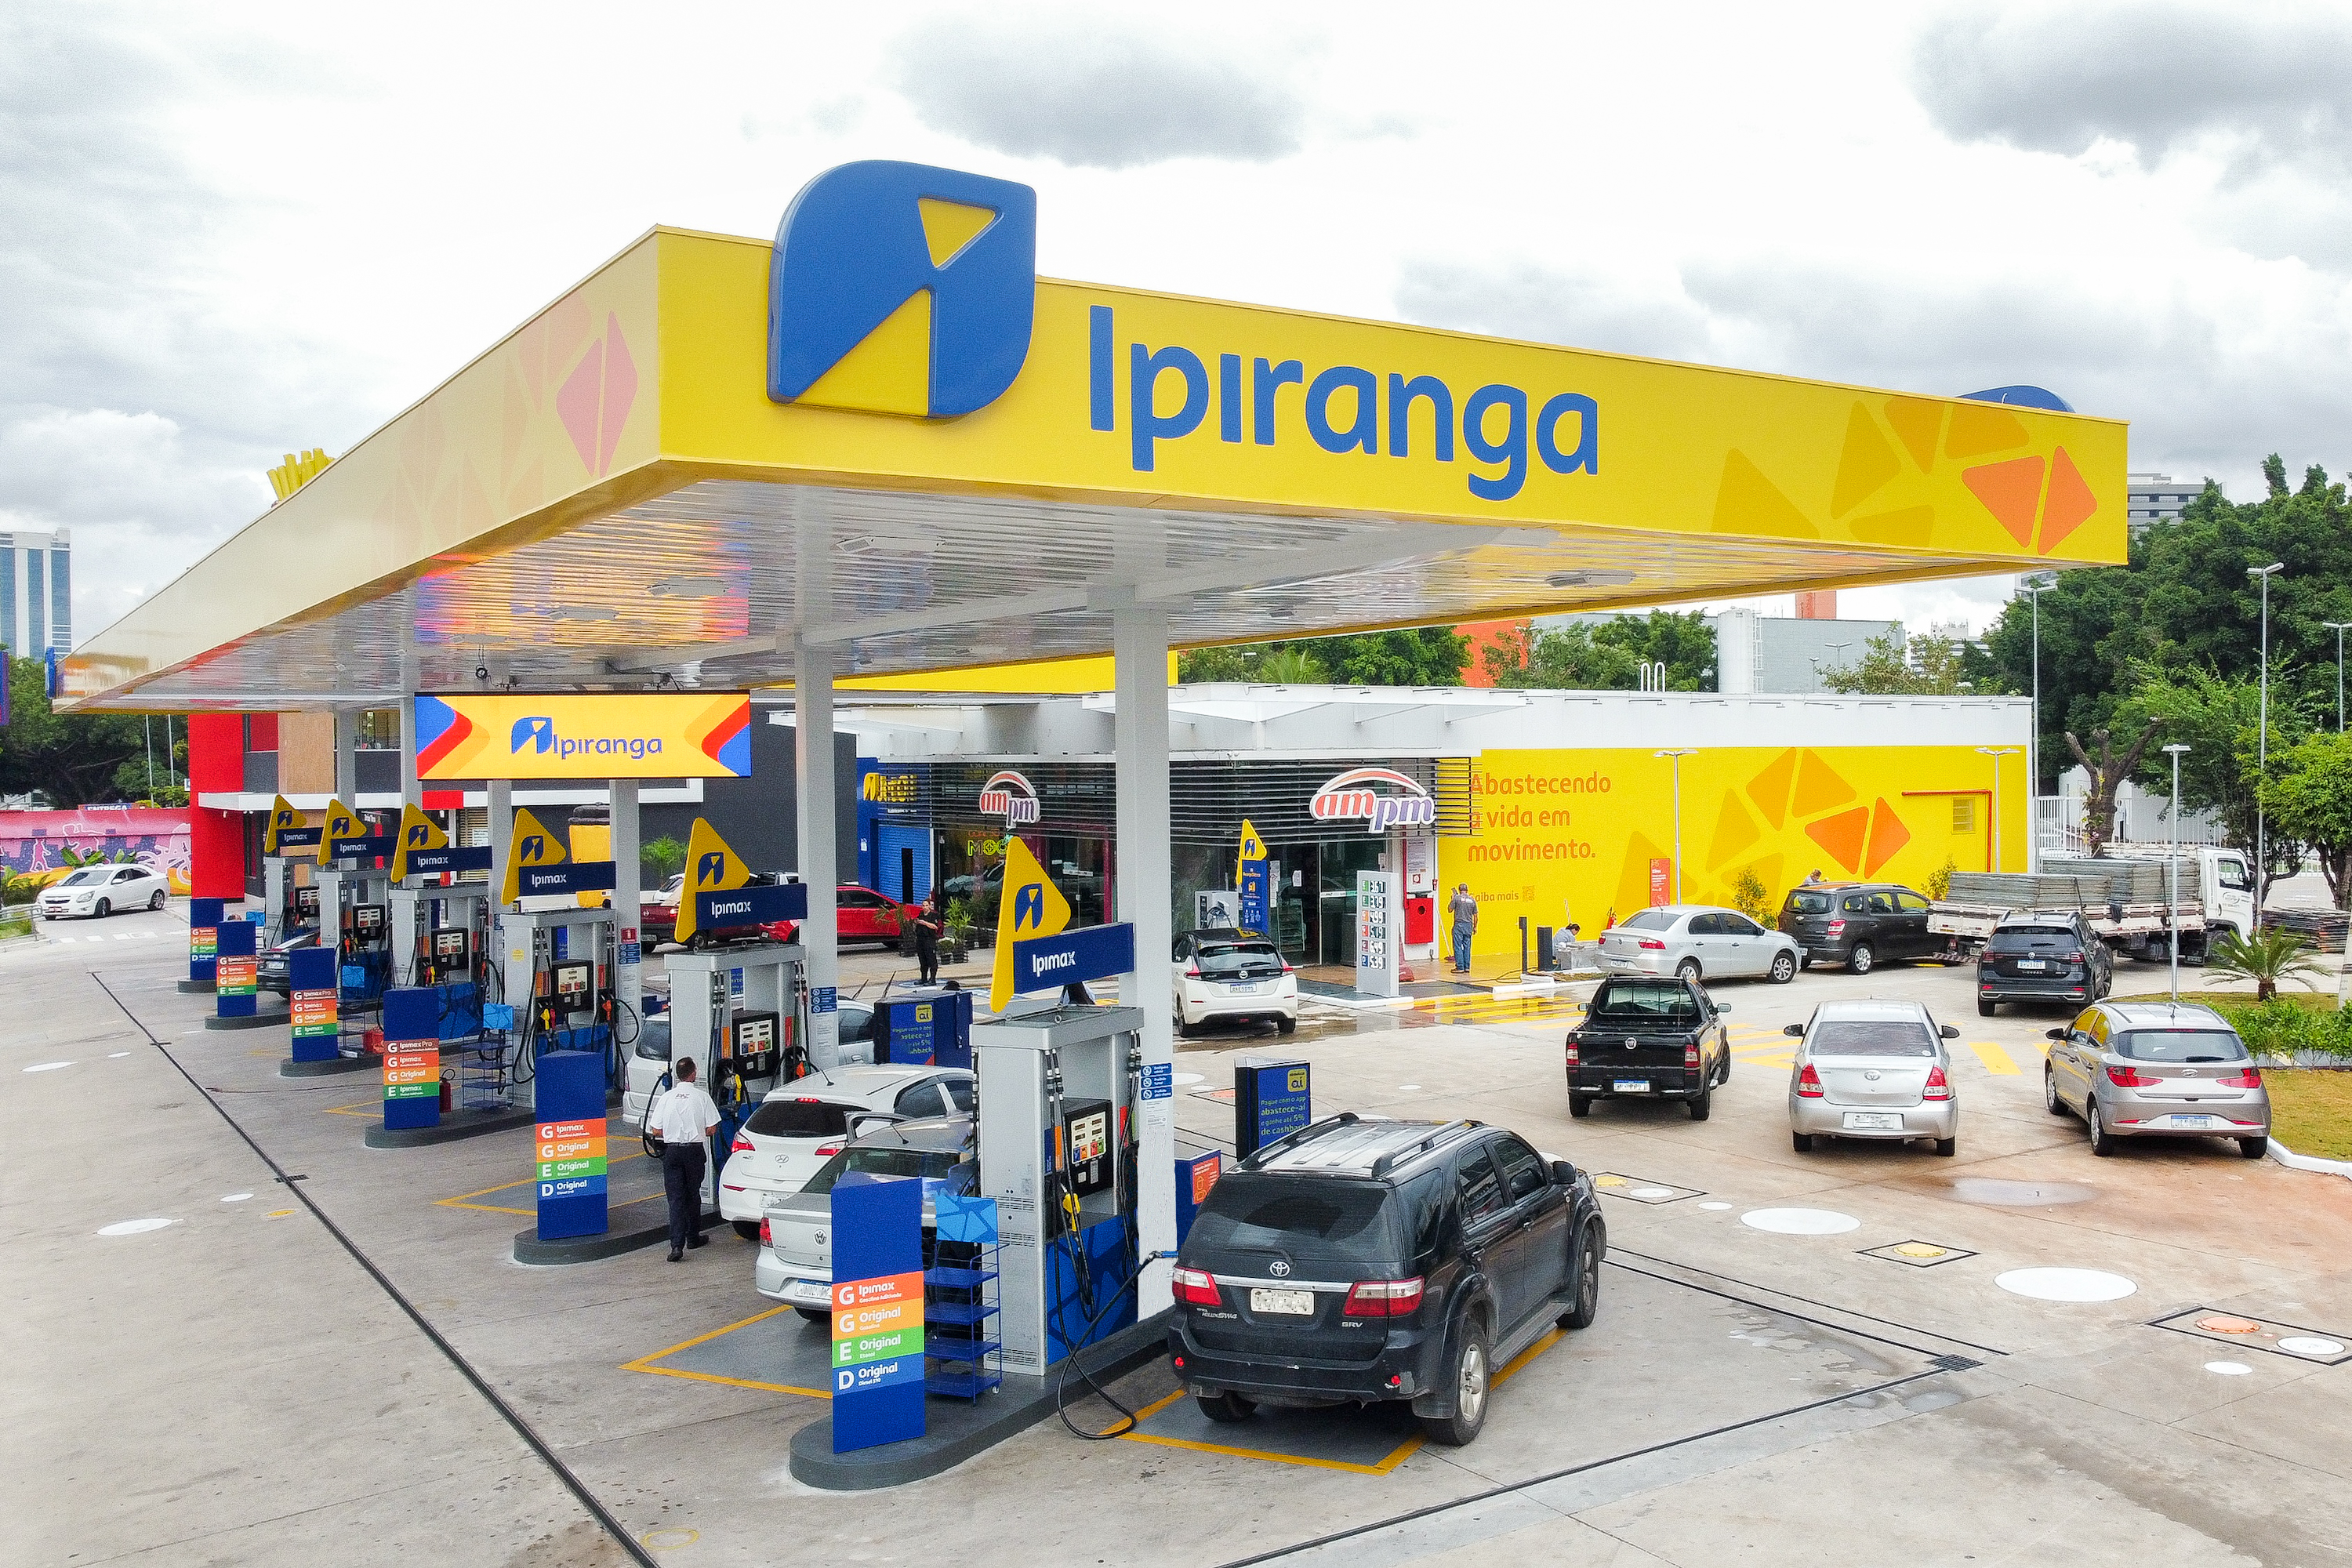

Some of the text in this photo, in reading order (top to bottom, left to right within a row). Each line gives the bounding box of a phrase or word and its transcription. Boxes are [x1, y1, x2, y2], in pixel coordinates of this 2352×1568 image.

[1090, 304, 1598, 501] Ipiranga
[554, 735, 662, 759] Ipiranga
[1471, 771, 1611, 795] Abastecendo
[980, 792, 1035, 827] ampm
[1314, 791, 1434, 832] ampm
[1486, 804, 1533, 827] vida
[1539, 810, 1570, 826] em
[339, 843, 367, 853] Ipimax
[1468, 837, 1595, 862] movimento.
[417, 855, 448, 867] Ipimax
[532, 873, 567, 887] Ipimax
[1497, 891, 1519, 901] mais
[711, 901, 751, 919] Ipimax
[1032, 951, 1076, 977] Ipimax
[294, 992, 302, 1000] G
[294, 1004, 303, 1012] G
[295, 1015, 303, 1024] G
[387, 1043, 397, 1053] G
[387, 1057, 397, 1067] G
[388, 1072, 397, 1082] G
[388, 1087, 396, 1097] E
[541, 1124, 584, 1138] G Ipimax
[541, 1142, 589, 1158] G Original
[542, 1160, 590, 1177] E Original
[541, 1180, 587, 1196] D Original
[839, 1286, 855, 1305] G
[858, 1282, 895, 1296] Ipimax
[839, 1306, 901, 1333] G Original
[839, 1334, 901, 1361] E Original
[839, 1362, 898, 1390] D Original
